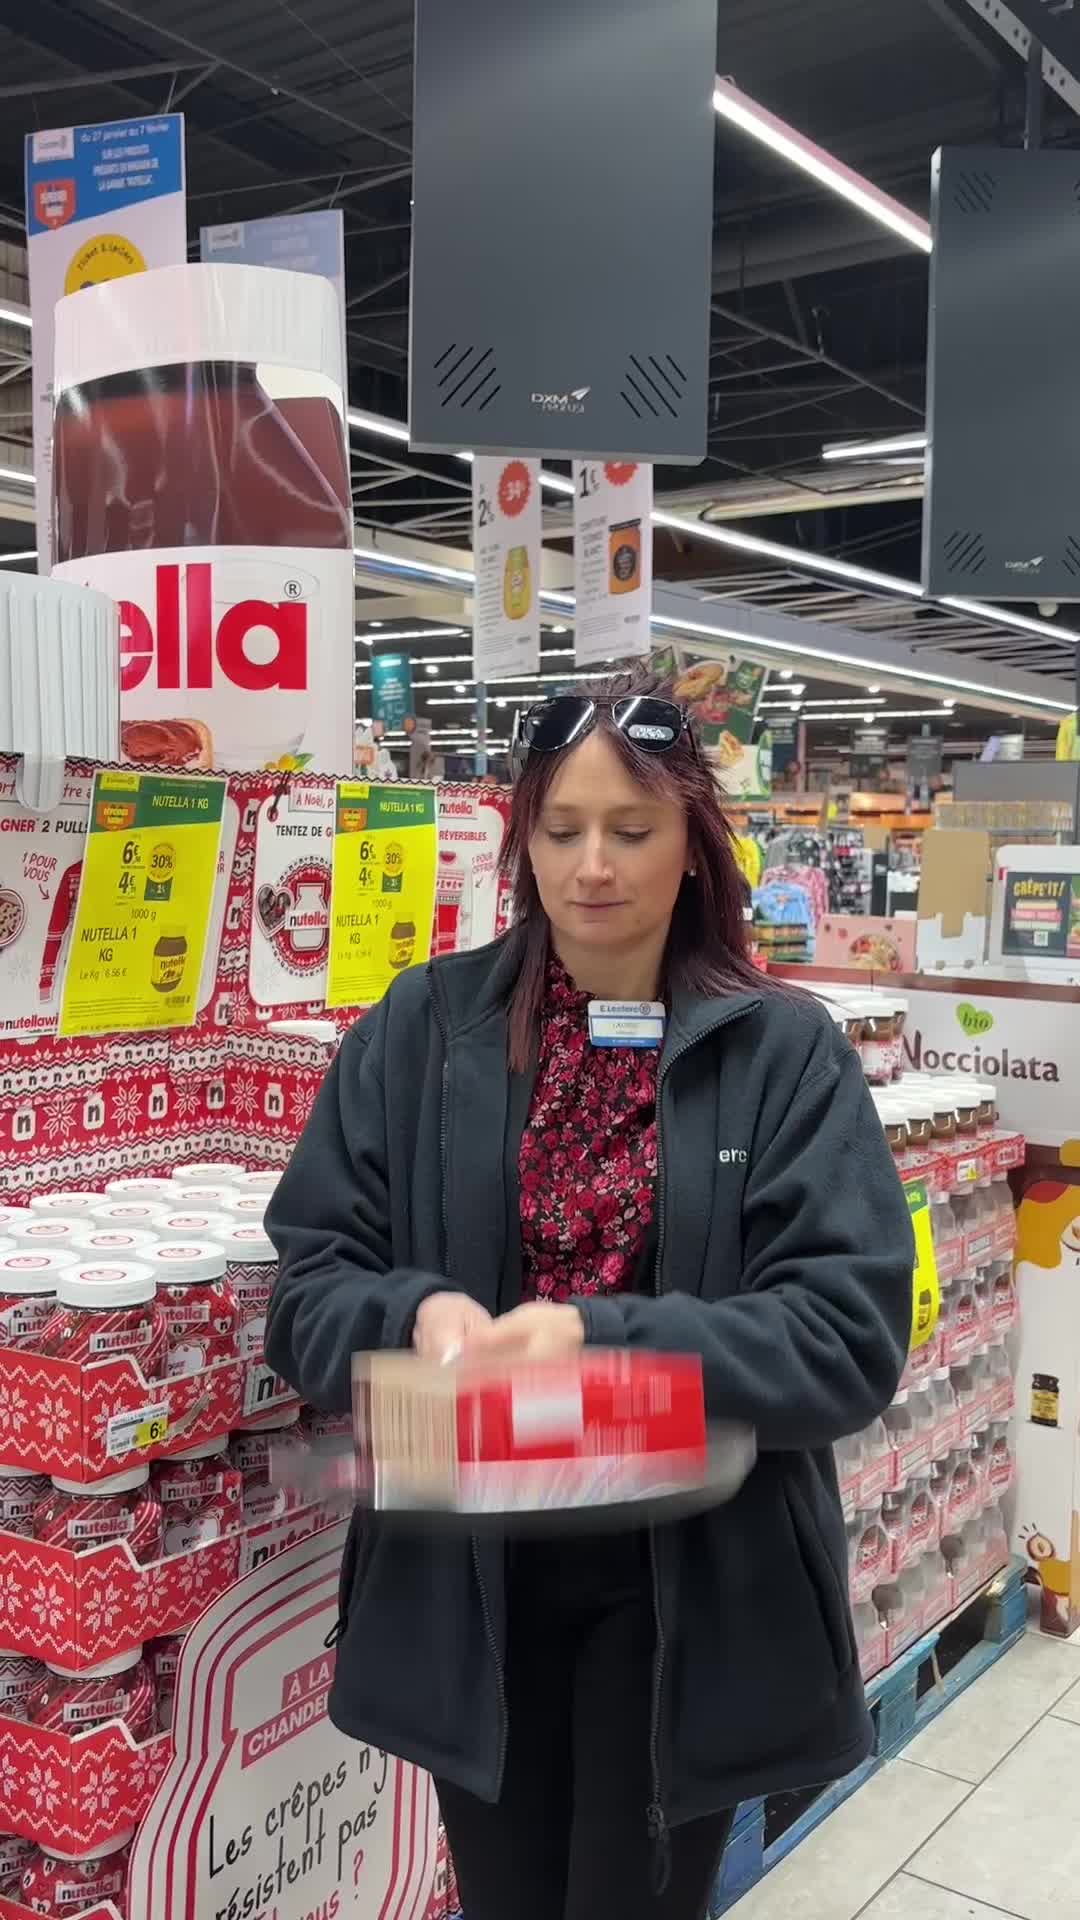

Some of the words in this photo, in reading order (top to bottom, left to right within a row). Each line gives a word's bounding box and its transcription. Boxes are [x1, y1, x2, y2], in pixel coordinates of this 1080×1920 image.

[531, 393, 569, 404] DXM
[152, 794, 189, 808] NUTELLA
[198, 798, 209, 809] KG
[380, 802, 408, 813] NUTELLA
[439, 802, 473, 815] nutella
[41, 820, 50, 832] 2
[276, 825, 308, 837] TENTEZ
[311, 826, 323, 837] DE
[439, 830, 487, 842] RÉVERSIBLES
[29, 853, 57, 871] POUR
[152, 854, 173, 869] 30%
[23, 867, 50, 882] VOUS
[290, 913, 327, 927] nutella
[336, 915, 371, 928] NUTELLA
[81, 927, 128, 942] NUTELLA
[130, 926, 137, 941] 1
[349, 932, 361, 945] KG
[98, 948, 113, 962] KG
[962, 1013, 990, 1031] bio
[902, 1029, 1060, 1082] Nocciolata
[96, 1330, 147, 1349] nutella
[168, 1480, 216, 1498] nutella
[74, 1520, 128, 1536] nutella
[287, 1672, 301, 1701] À
[308, 1661, 329, 1689] LA
[71, 1701, 124, 1719] nutella
[209, 1815, 253, 1880] Les
[264, 1760, 348, 1844] crêpes
[337, 1799, 377, 1883] pas
[62, 1882, 114, 1900] nutella
